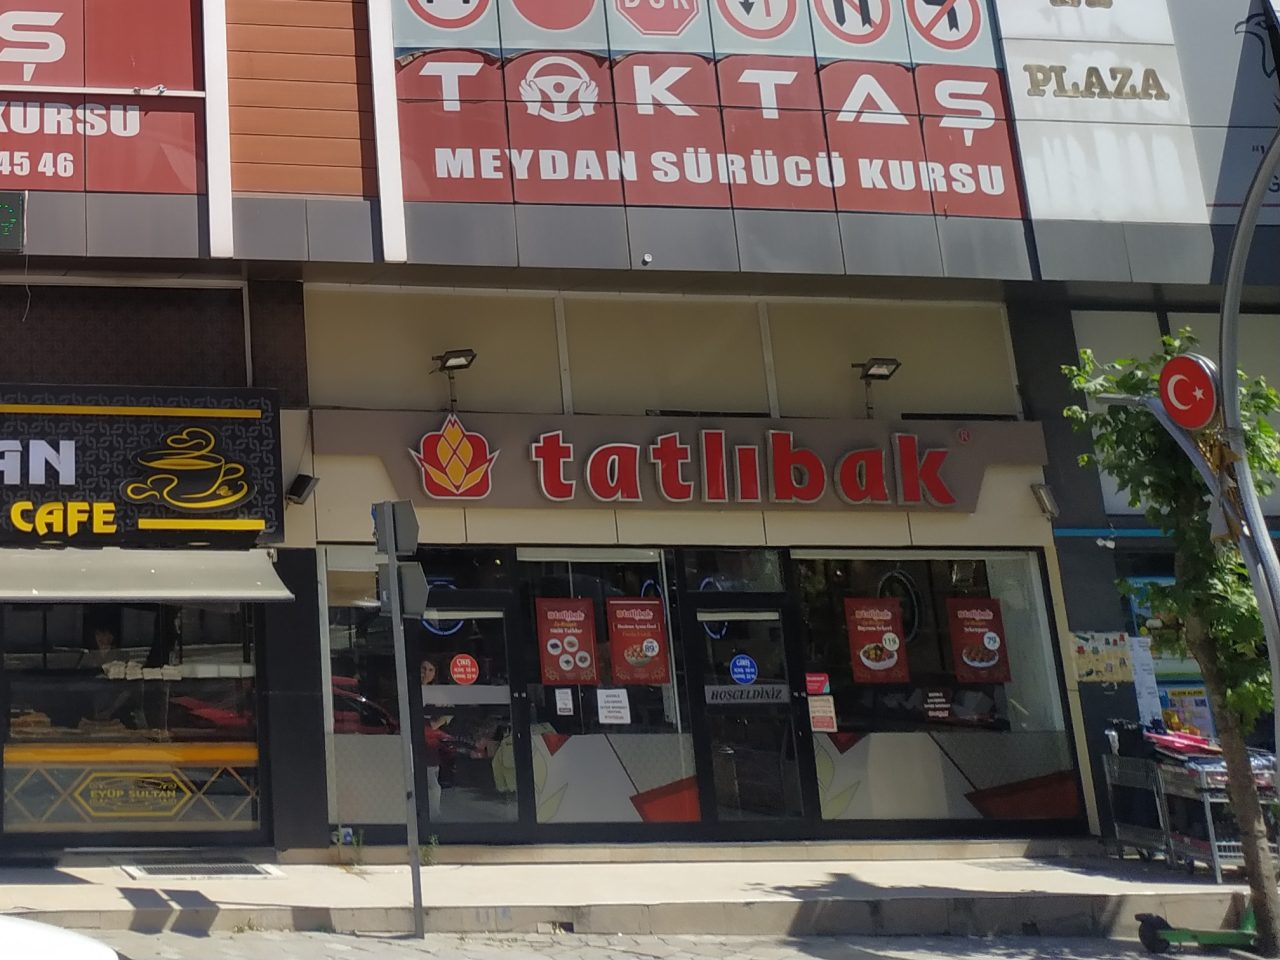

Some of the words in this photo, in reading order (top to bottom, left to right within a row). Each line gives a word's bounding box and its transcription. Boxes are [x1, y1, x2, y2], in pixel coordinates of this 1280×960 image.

[1023, 64, 1171, 101] PLAZA
[37, 152, 74, 178] 46
[434, 147, 639, 182] MEYDAN
[650, 146, 847, 189] SÜRÜCÜ
[857, 157, 1006, 196] KURSU
[529, 428, 958, 508] tatlıbak
[9, 500, 118, 536] CAFE
